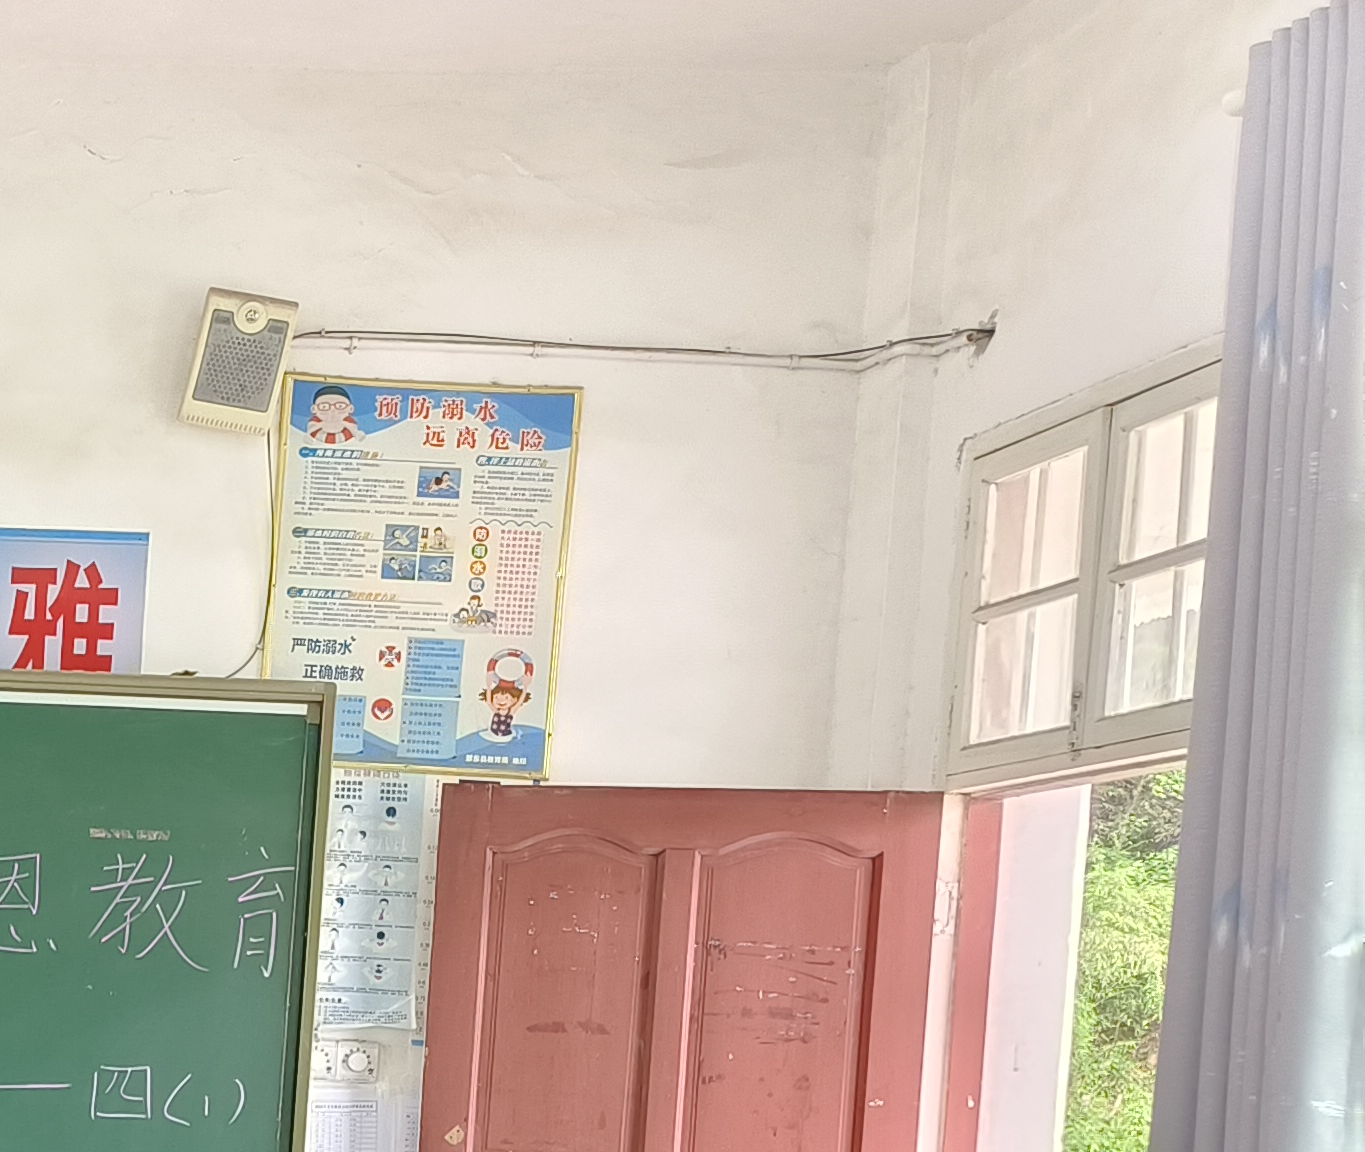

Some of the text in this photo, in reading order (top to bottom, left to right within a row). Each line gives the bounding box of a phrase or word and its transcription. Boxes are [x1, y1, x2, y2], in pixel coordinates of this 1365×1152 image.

[375, 395, 499, 422] 预防溺水
[422, 425, 546, 451] 远离危险
[291, 638, 353, 655] 严防溺水
[302, 664, 364, 682] 正确施救
